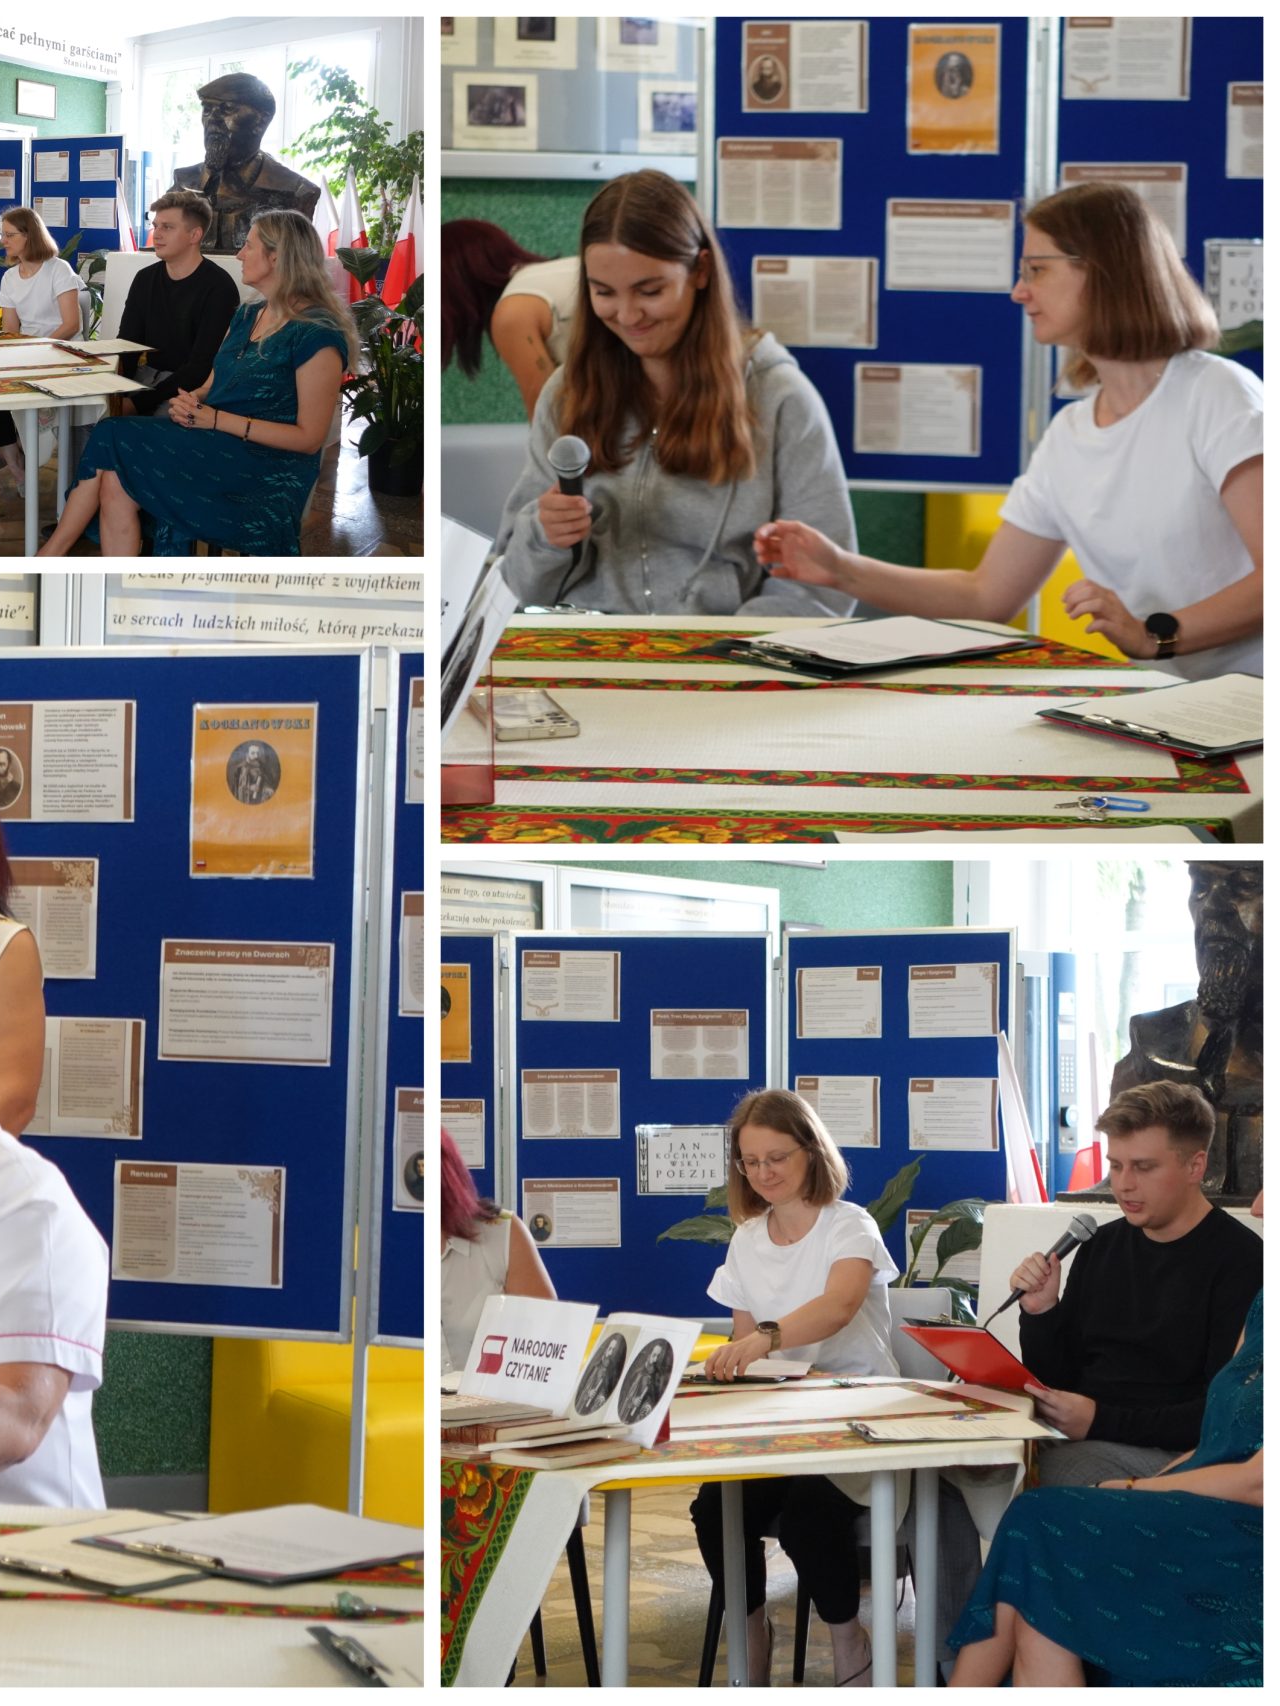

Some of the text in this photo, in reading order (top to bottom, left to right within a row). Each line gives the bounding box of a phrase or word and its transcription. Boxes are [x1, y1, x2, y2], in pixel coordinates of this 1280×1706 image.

[20, 31, 66, 52] pełnymi
[275, 574, 326, 592] pamięć
[332, 577, 340, 587] z
[345, 576, 421, 593] wyjątkiem
[113, 613, 127, 625] w
[130, 613, 183, 628] sercach
[192, 614, 256, 631] ludzkich
[260, 616, 309, 635] miłość,
[318, 620, 356, 638] którą
[200, 718, 310, 731] KOCHANOWSKI
[463, 888, 480, 898] tego,
[492, 889, 526, 900] utwierdza
[472, 915, 490, 924] sobie
[175, 948, 216, 958] Znaczenie
[217, 951, 240, 960] pracy
[253, 950, 290, 959] Dworach
[669, 1142, 701, 1153] JAN
[656, 1152, 716, 1160] KOCHANO
[129, 1169, 168, 1179] Renesans
[655, 1169, 717, 1179] POEZJE
[511, 1337, 568, 1360] NARODOWE
[505, 1361, 552, 1383] CZYTANIE
